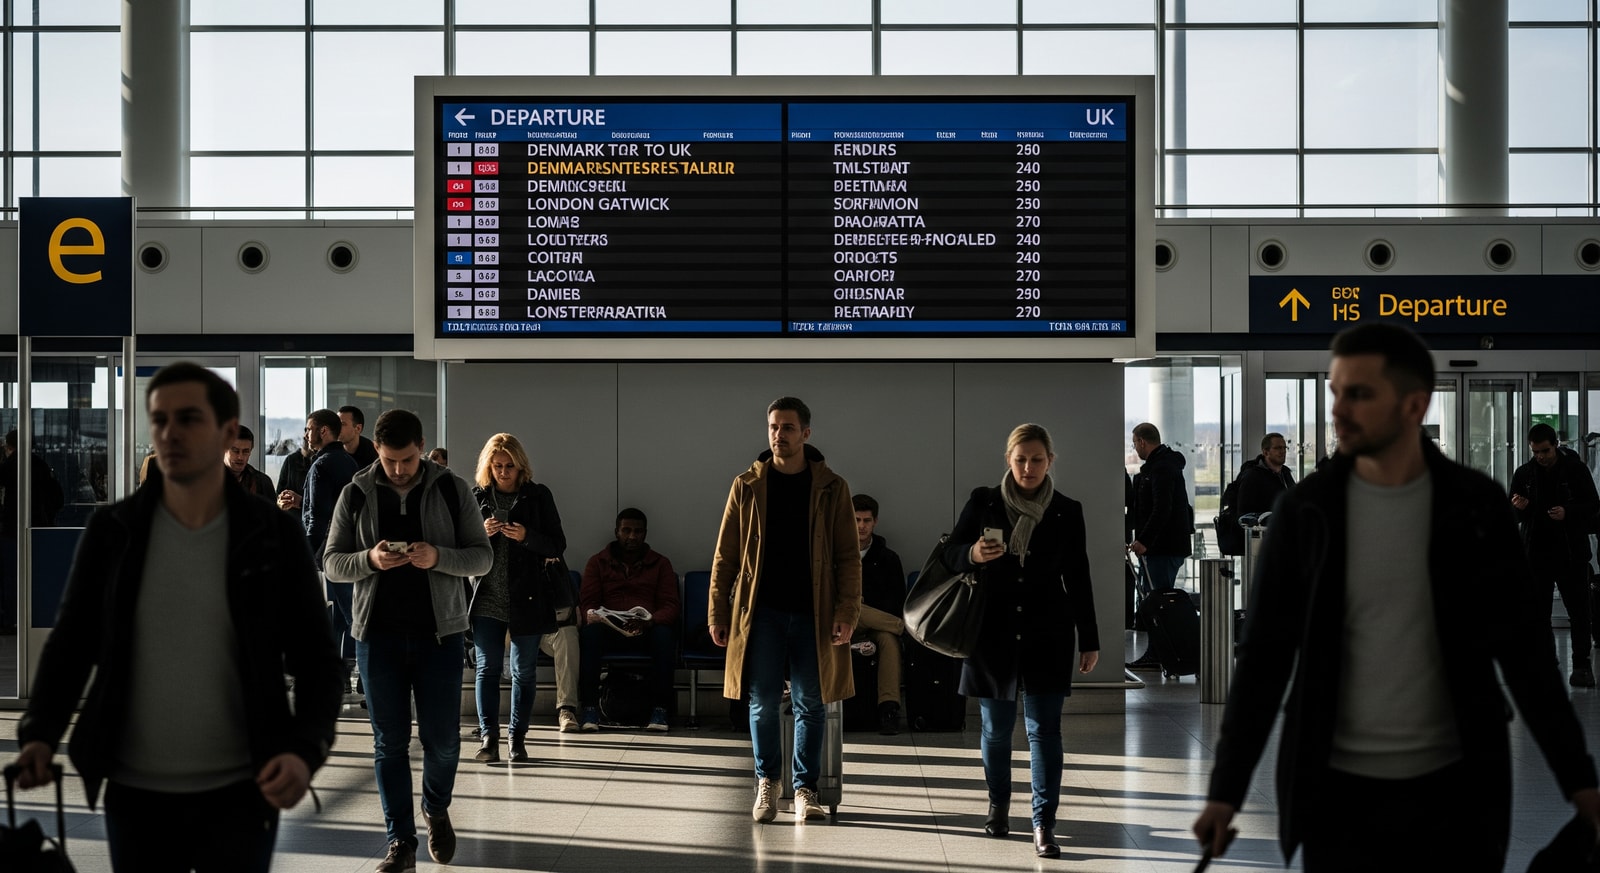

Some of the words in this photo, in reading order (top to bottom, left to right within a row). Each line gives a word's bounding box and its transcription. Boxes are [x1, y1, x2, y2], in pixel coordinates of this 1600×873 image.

[491, 109, 605, 126] DEPARTURE
[1086, 108, 1115, 126] UK
[527, 144, 605, 156] DENMARK
[644, 144, 665, 156] TO
[669, 144, 692, 156] UK
[1016, 161, 1041, 174] 240
[527, 197, 594, 210] LONDON
[598, 197, 670, 210] GATWICK
[1016, 215, 1041, 228] 270
[1016, 233, 1041, 246] 240
[48, 217, 106, 284] e
[1016, 251, 1041, 264] 240
[1016, 270, 1041, 282] 270
[1379, 293, 1508, 322] Departure
